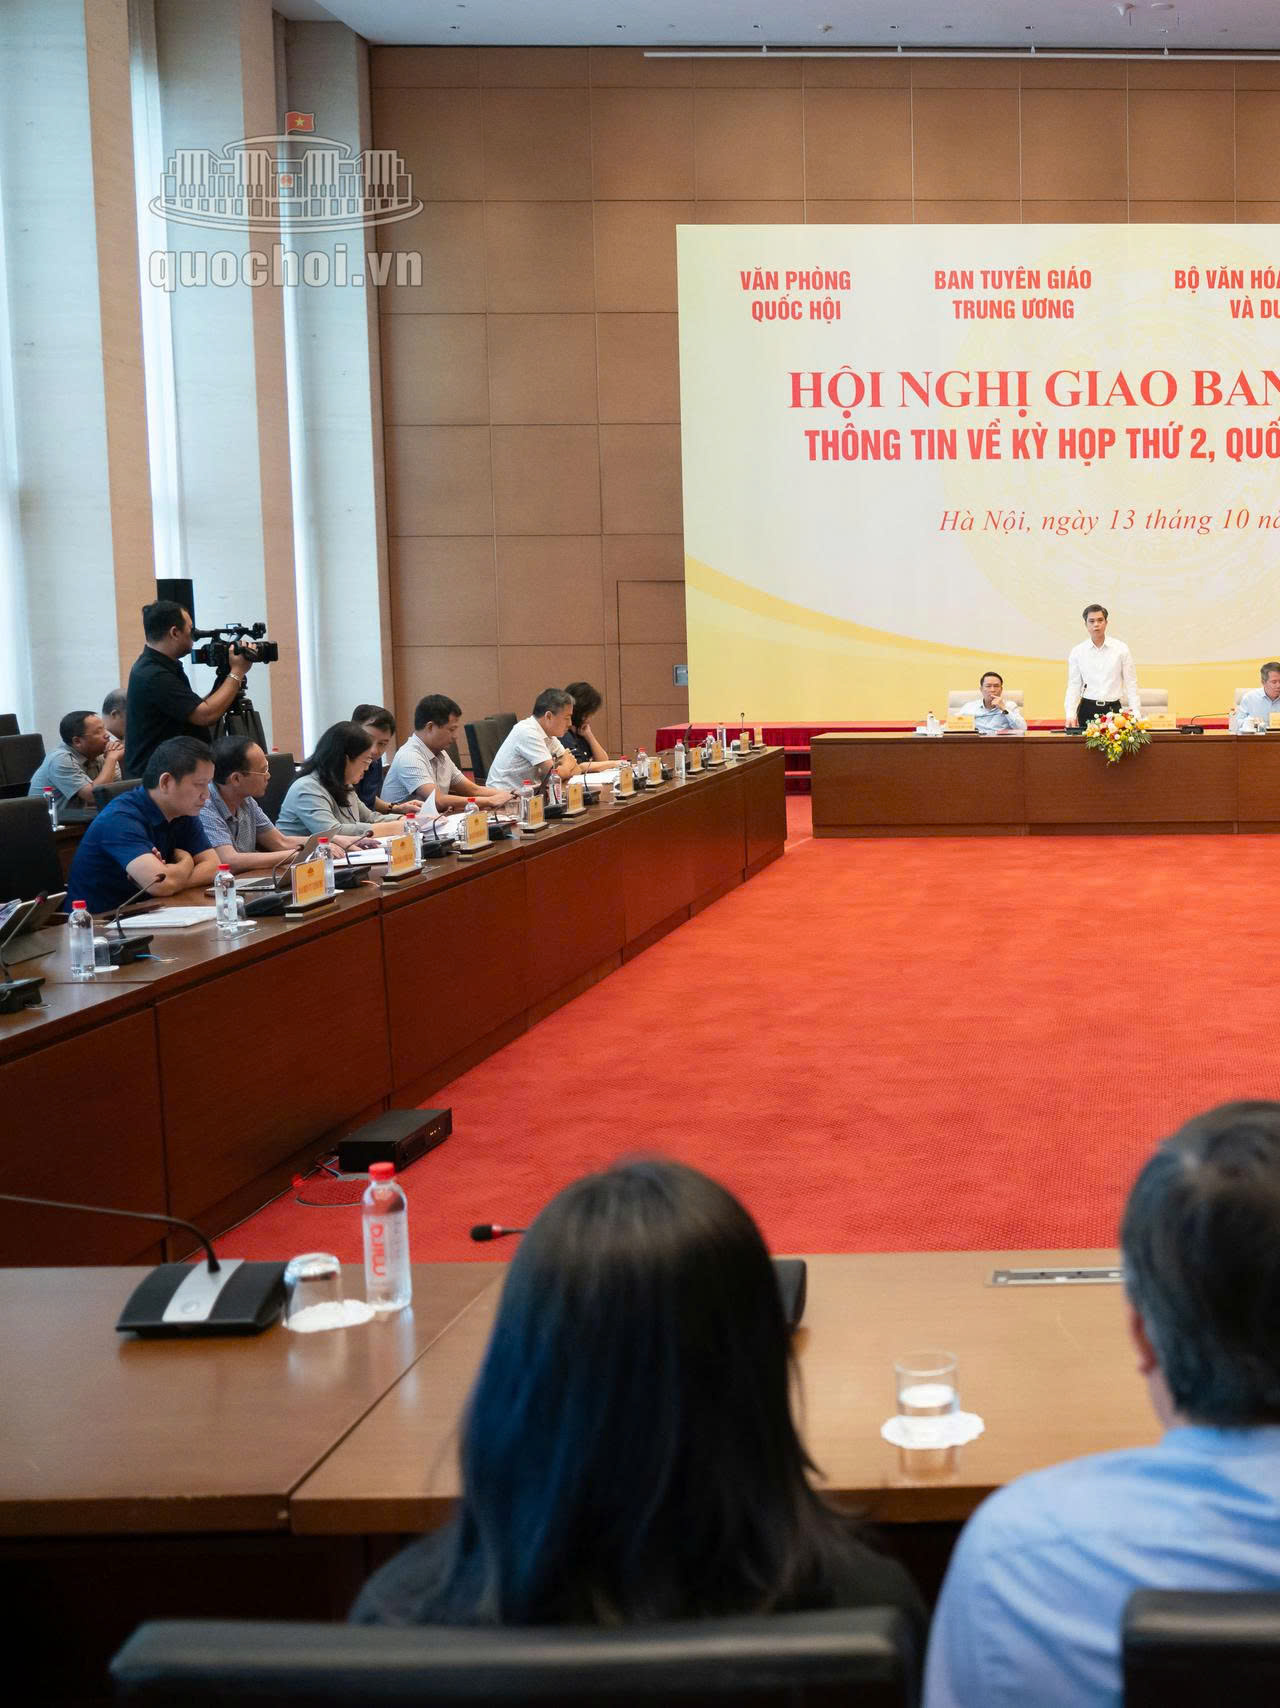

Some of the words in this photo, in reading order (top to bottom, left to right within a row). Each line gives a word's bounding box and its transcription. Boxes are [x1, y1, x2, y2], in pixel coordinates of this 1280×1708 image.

[740, 265, 780, 291] VĂN
[785, 266, 852, 291] PHÒNG
[934, 270, 975, 290] BAN
[979, 265, 1041, 290] TUYÊN
[1047, 265, 1093, 290] GIÁO
[1174, 265, 1200, 294] BỘ
[1205, 265, 1245, 290] VĂN
[751, 294, 803, 322] QUỐC
[809, 296, 842, 324] HỘI
[952, 299, 1016, 320] TRUNG
[1022, 297, 1075, 320] ƯƠNG
[1229, 295, 1255, 320] VÀ
[788, 365, 886, 419] HỘI
[897, 370, 1032, 418] NGHỊ
[1045, 369, 1178, 407] GIAO
[803, 422, 902, 461] THÔNG
[909, 428, 958, 461] TIN
[966, 418, 1002, 461] VỀ
[1011, 421, 1049, 460] KỲ
[1058, 427, 1117, 467] HỌP
[1125, 420, 1184, 460] THỨ
[1189, 427, 1216, 463] 2,
[938, 510, 975, 531] Hà
[983, 510, 1032, 537] Nội,
[1041, 511, 1099, 537] ngày
[1110, 509, 1136, 530] 13
[1145, 508, 1213, 535] tháng
[1223, 508, 1250, 529] 10
[369, 1222, 386, 1277] mira
